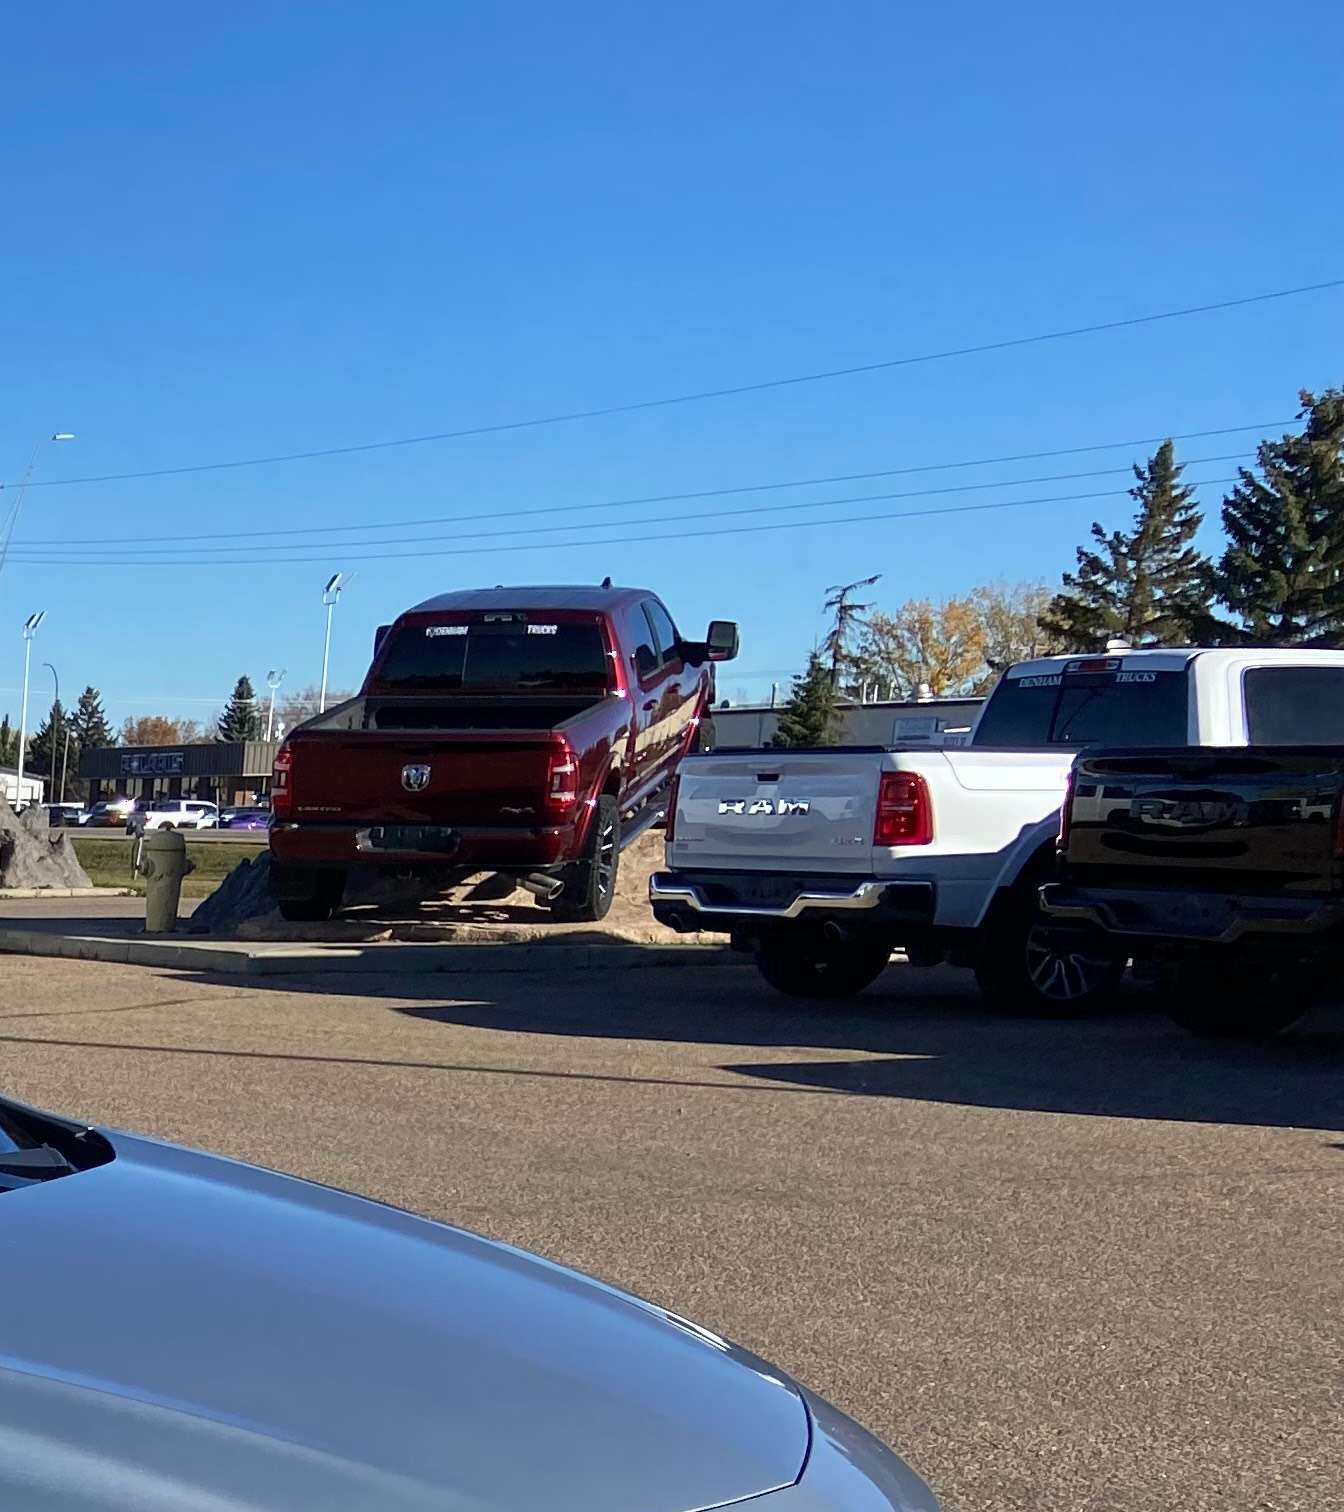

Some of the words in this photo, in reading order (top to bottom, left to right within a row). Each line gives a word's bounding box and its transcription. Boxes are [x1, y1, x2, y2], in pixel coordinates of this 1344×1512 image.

[1018, 676, 1062, 688] DENHAM
[1115, 672, 1157, 684] TRUCKS
[718, 799, 811, 816] RAM
